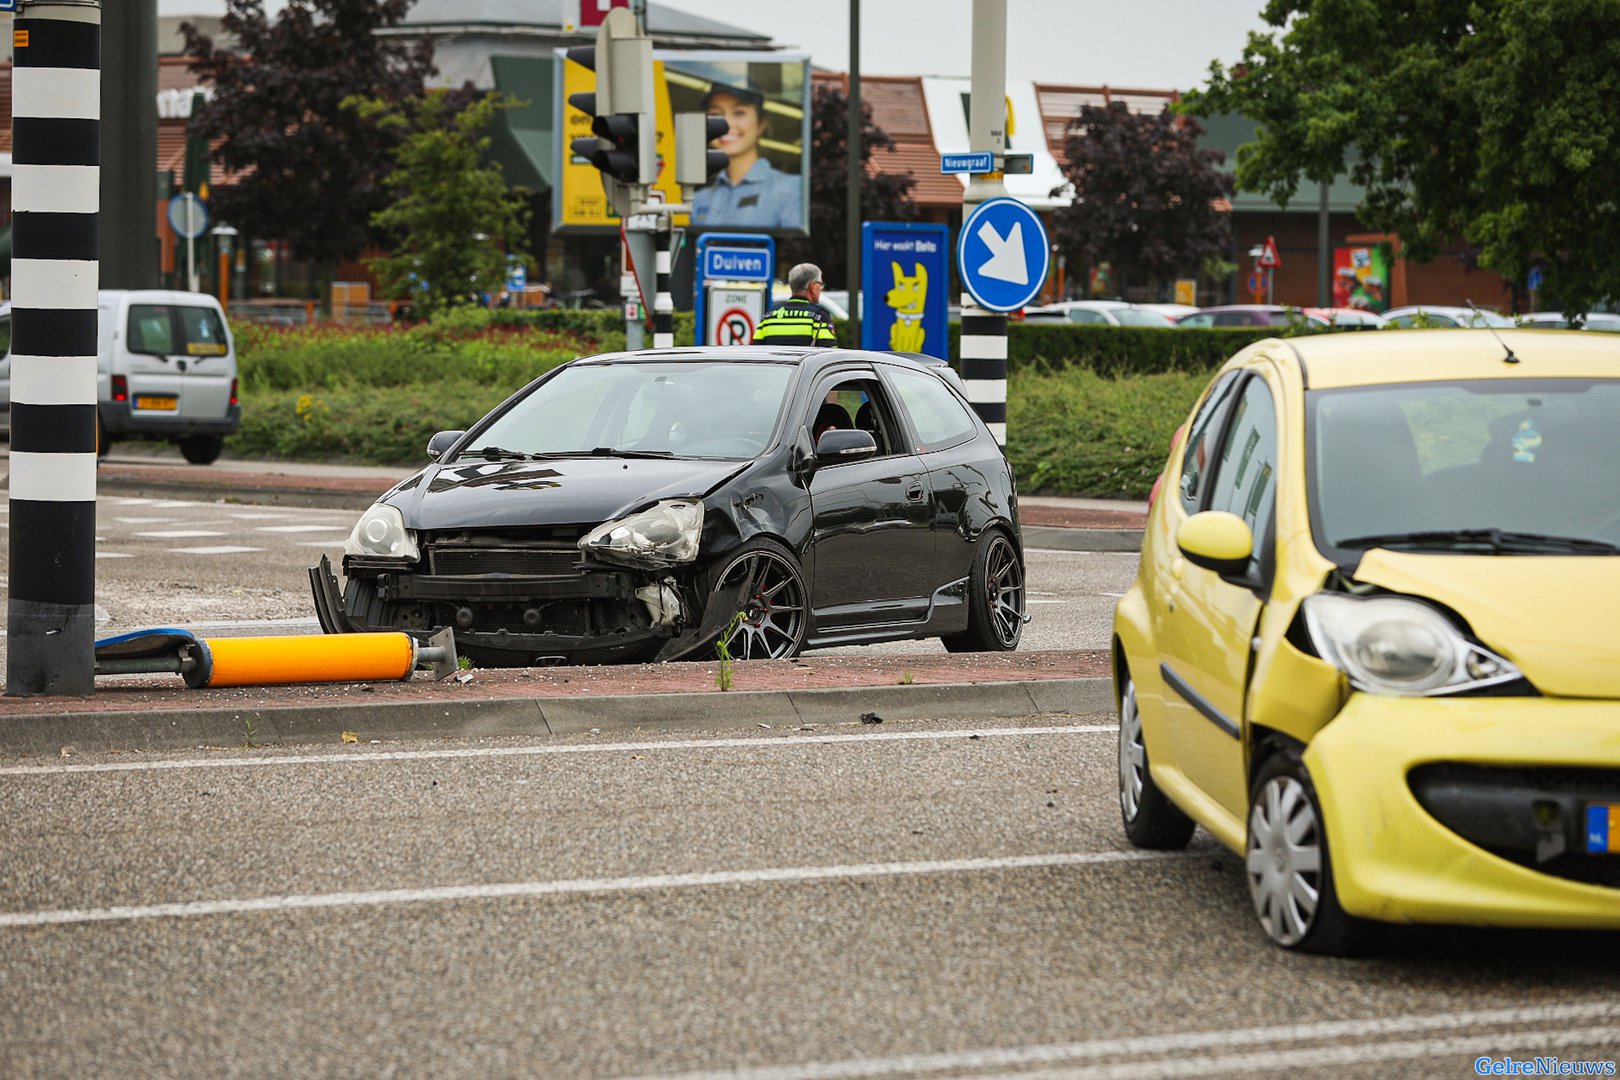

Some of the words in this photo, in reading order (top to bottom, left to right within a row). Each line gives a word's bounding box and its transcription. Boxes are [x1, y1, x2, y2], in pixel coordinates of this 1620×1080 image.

[944, 156, 987, 169] Nieuwgraaf
[915, 240, 937, 253] Bello
[713, 253, 762, 272] Duiven
[725, 294, 748, 304] ZONE
